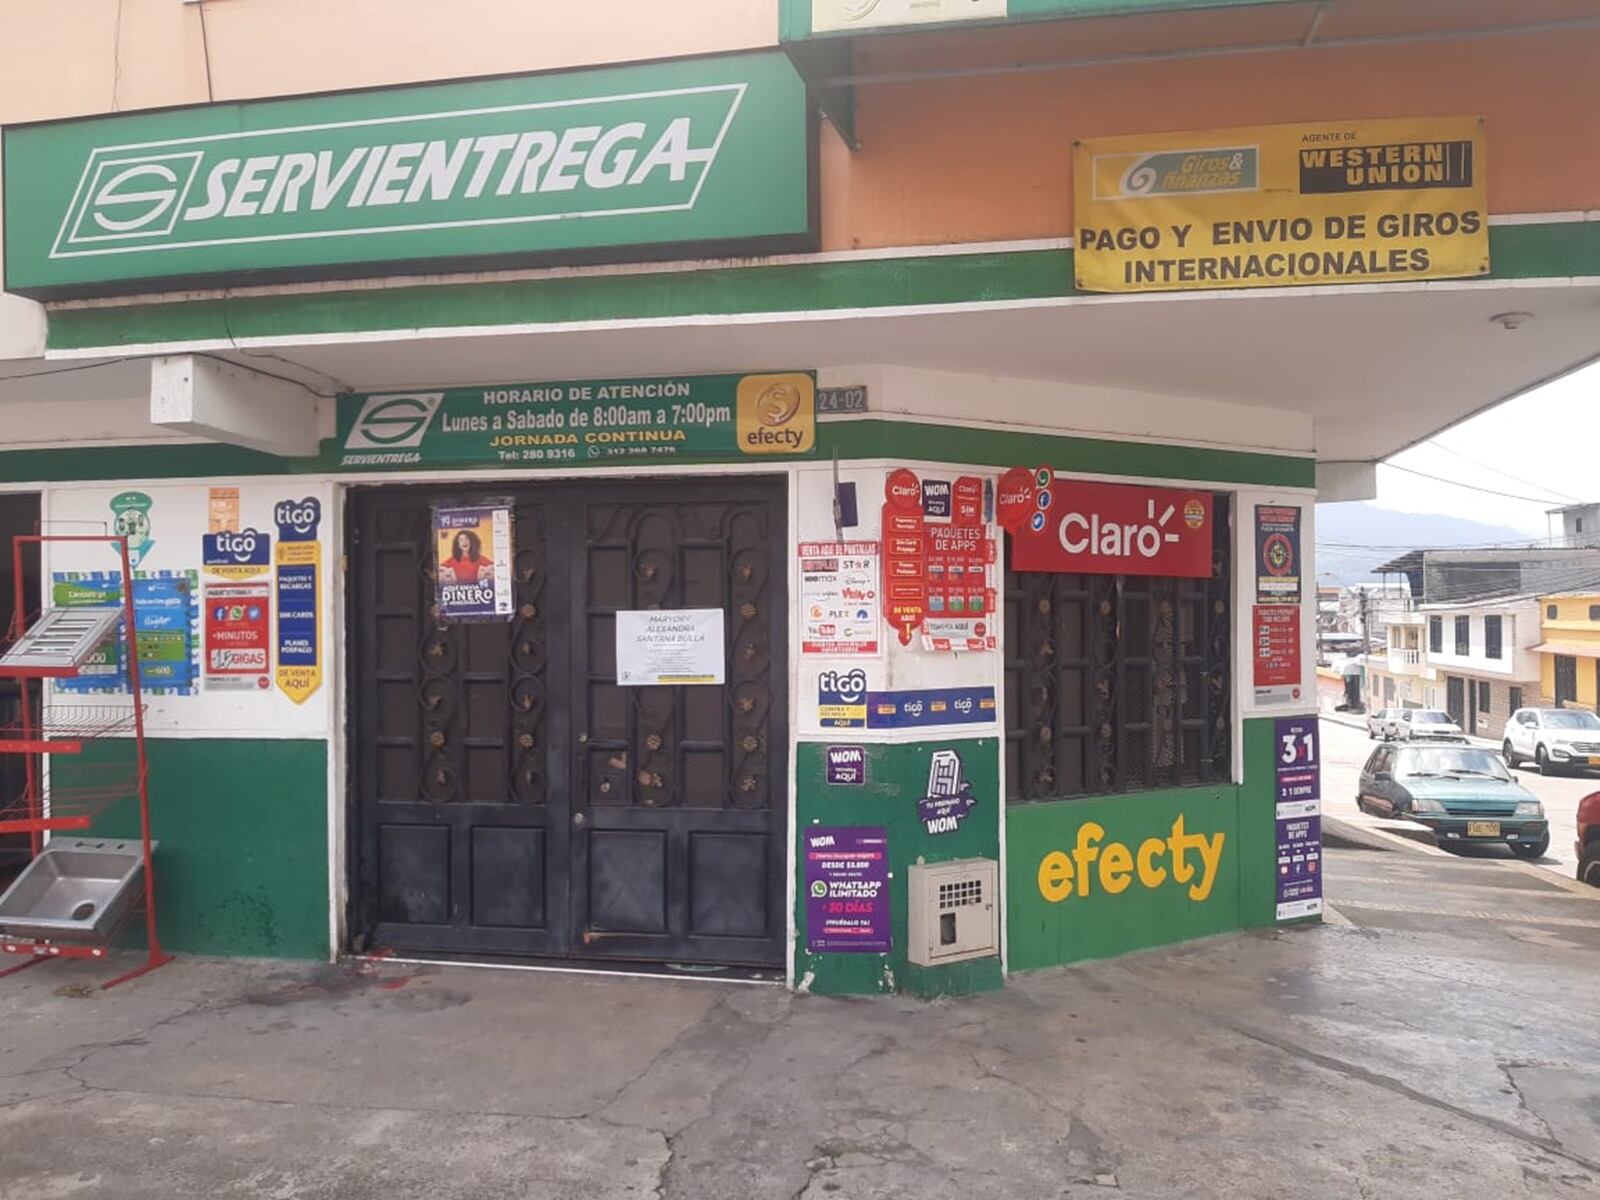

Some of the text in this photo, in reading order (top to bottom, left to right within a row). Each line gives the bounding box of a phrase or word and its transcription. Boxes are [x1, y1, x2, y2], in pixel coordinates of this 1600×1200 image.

[1302, 132, 1357, 142] AGENTE DE
[1301, 143, 1443, 169] WESTERN
[183, 117, 697, 220] SERVIENTREGA
[1346, 163, 1444, 186] UNION
[1080, 210, 1481, 251] PAGO Y ENVIO DE GIROS
[1124, 247, 1430, 284] INTERNACIONALES
[483, 380, 691, 405] HORARIO DE ATENCIÓN
[818, 389, 864, 409] 24-02
[441, 402, 732, 433] Lunes a Sabado de 8:00am a 7:00pm
[489, 430, 687, 448] JORNADA CONTINUA
[747, 425, 803, 449] efecty
[340, 451, 422, 466] SERVIENTREGA
[498, 451, 519, 461] Tel:
[892, 484, 917, 497] Claro
[924, 484, 950, 496] WOM
[999, 489, 1028, 505] Claro
[930, 527, 981, 540] PAQUETES
[1059, 504, 1168, 558] Claro
[935, 540, 977, 552] DE APPS
[442, 588, 494, 604] DINERO
[820, 670, 865, 695] tigo
[830, 750, 862, 764] WOM
[927, 816, 958, 834] WOM
[809, 835, 836, 848] WOM
[1037, 812, 1226, 903] efecty
[829, 881, 882, 890] WHATSAPP
[829, 889, 878, 898] ILIMITADO
